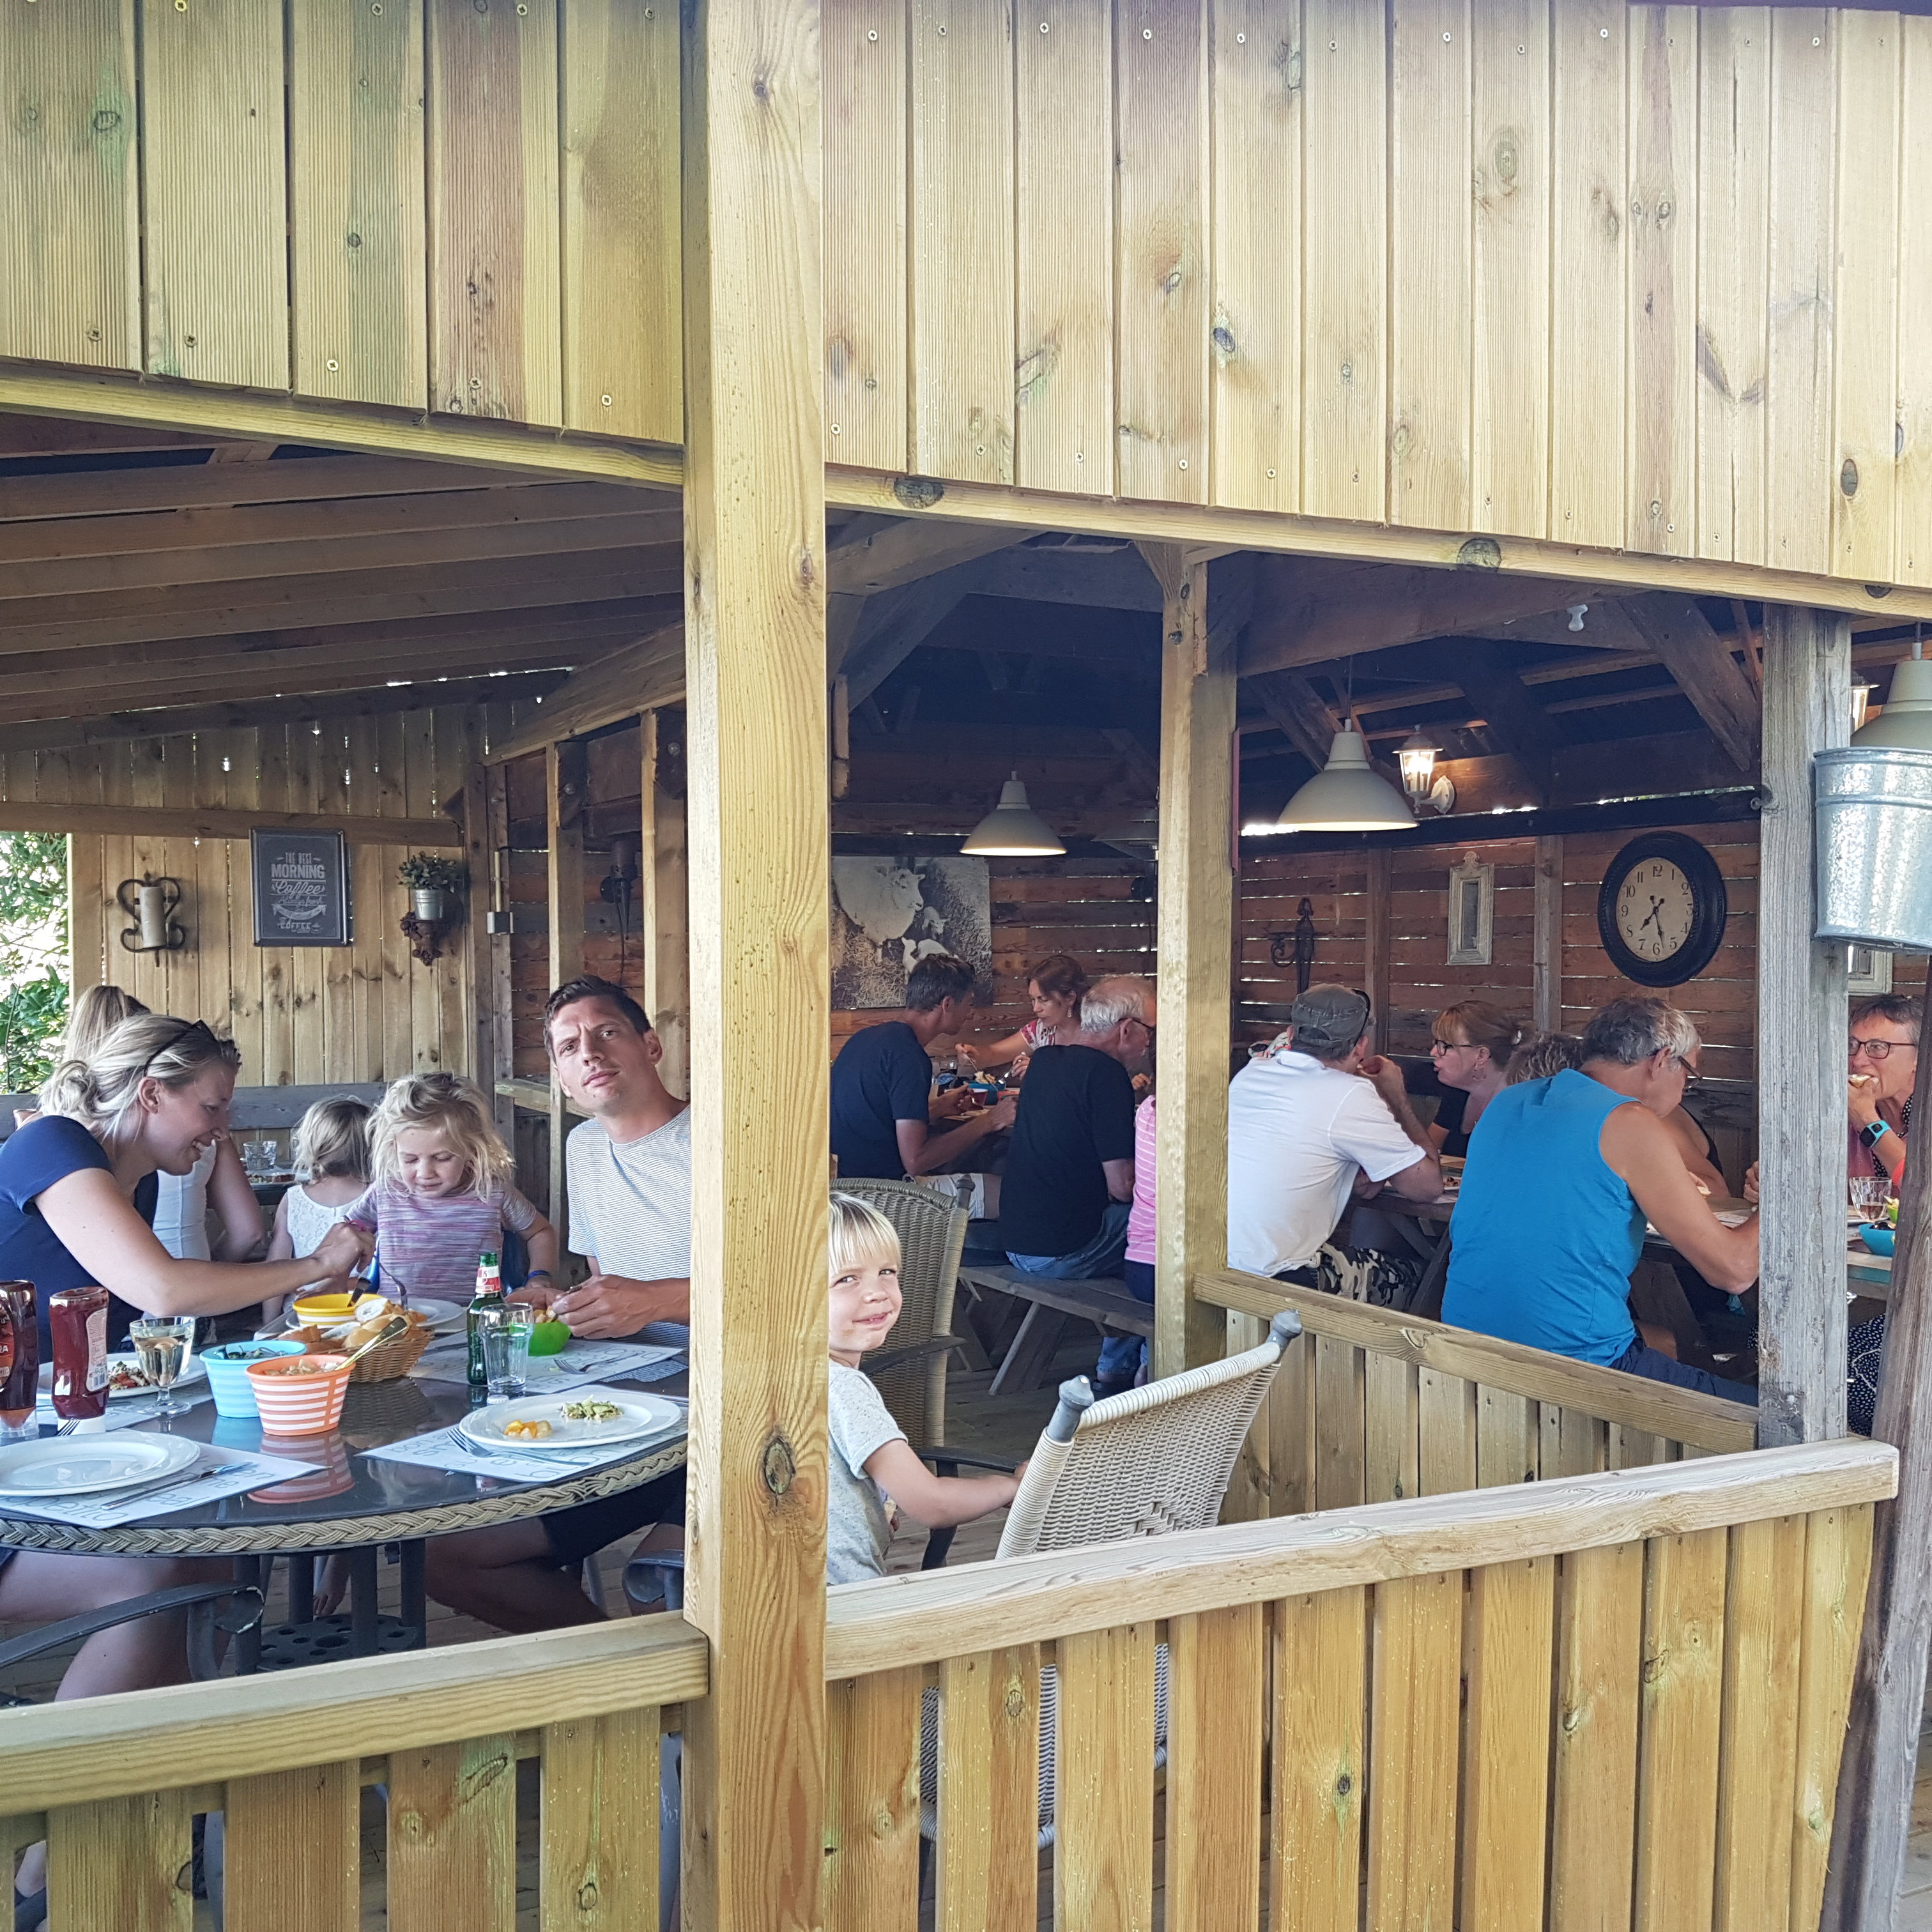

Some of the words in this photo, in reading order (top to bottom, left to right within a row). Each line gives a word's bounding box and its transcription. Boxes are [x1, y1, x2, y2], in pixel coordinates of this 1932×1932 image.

[285, 852, 295, 864] THE
[298, 852, 312, 864] BEST
[271, 863, 325, 879] MORNING
[1652, 864, 1663, 877] 12
[1636, 871, 1643, 884] 11
[275, 880, 322, 899] Coffee
[1626, 885, 1636, 898] 10
[1682, 882, 1689, 896] 2
[1621, 905, 1629, 917] 9
[1627, 924, 1634, 938] 8
[1680, 922, 1689, 935] 4
[1638, 939, 1646, 951] 7
[1652, 942, 1660, 955] 6
[1669, 937, 1677, 950] 5
